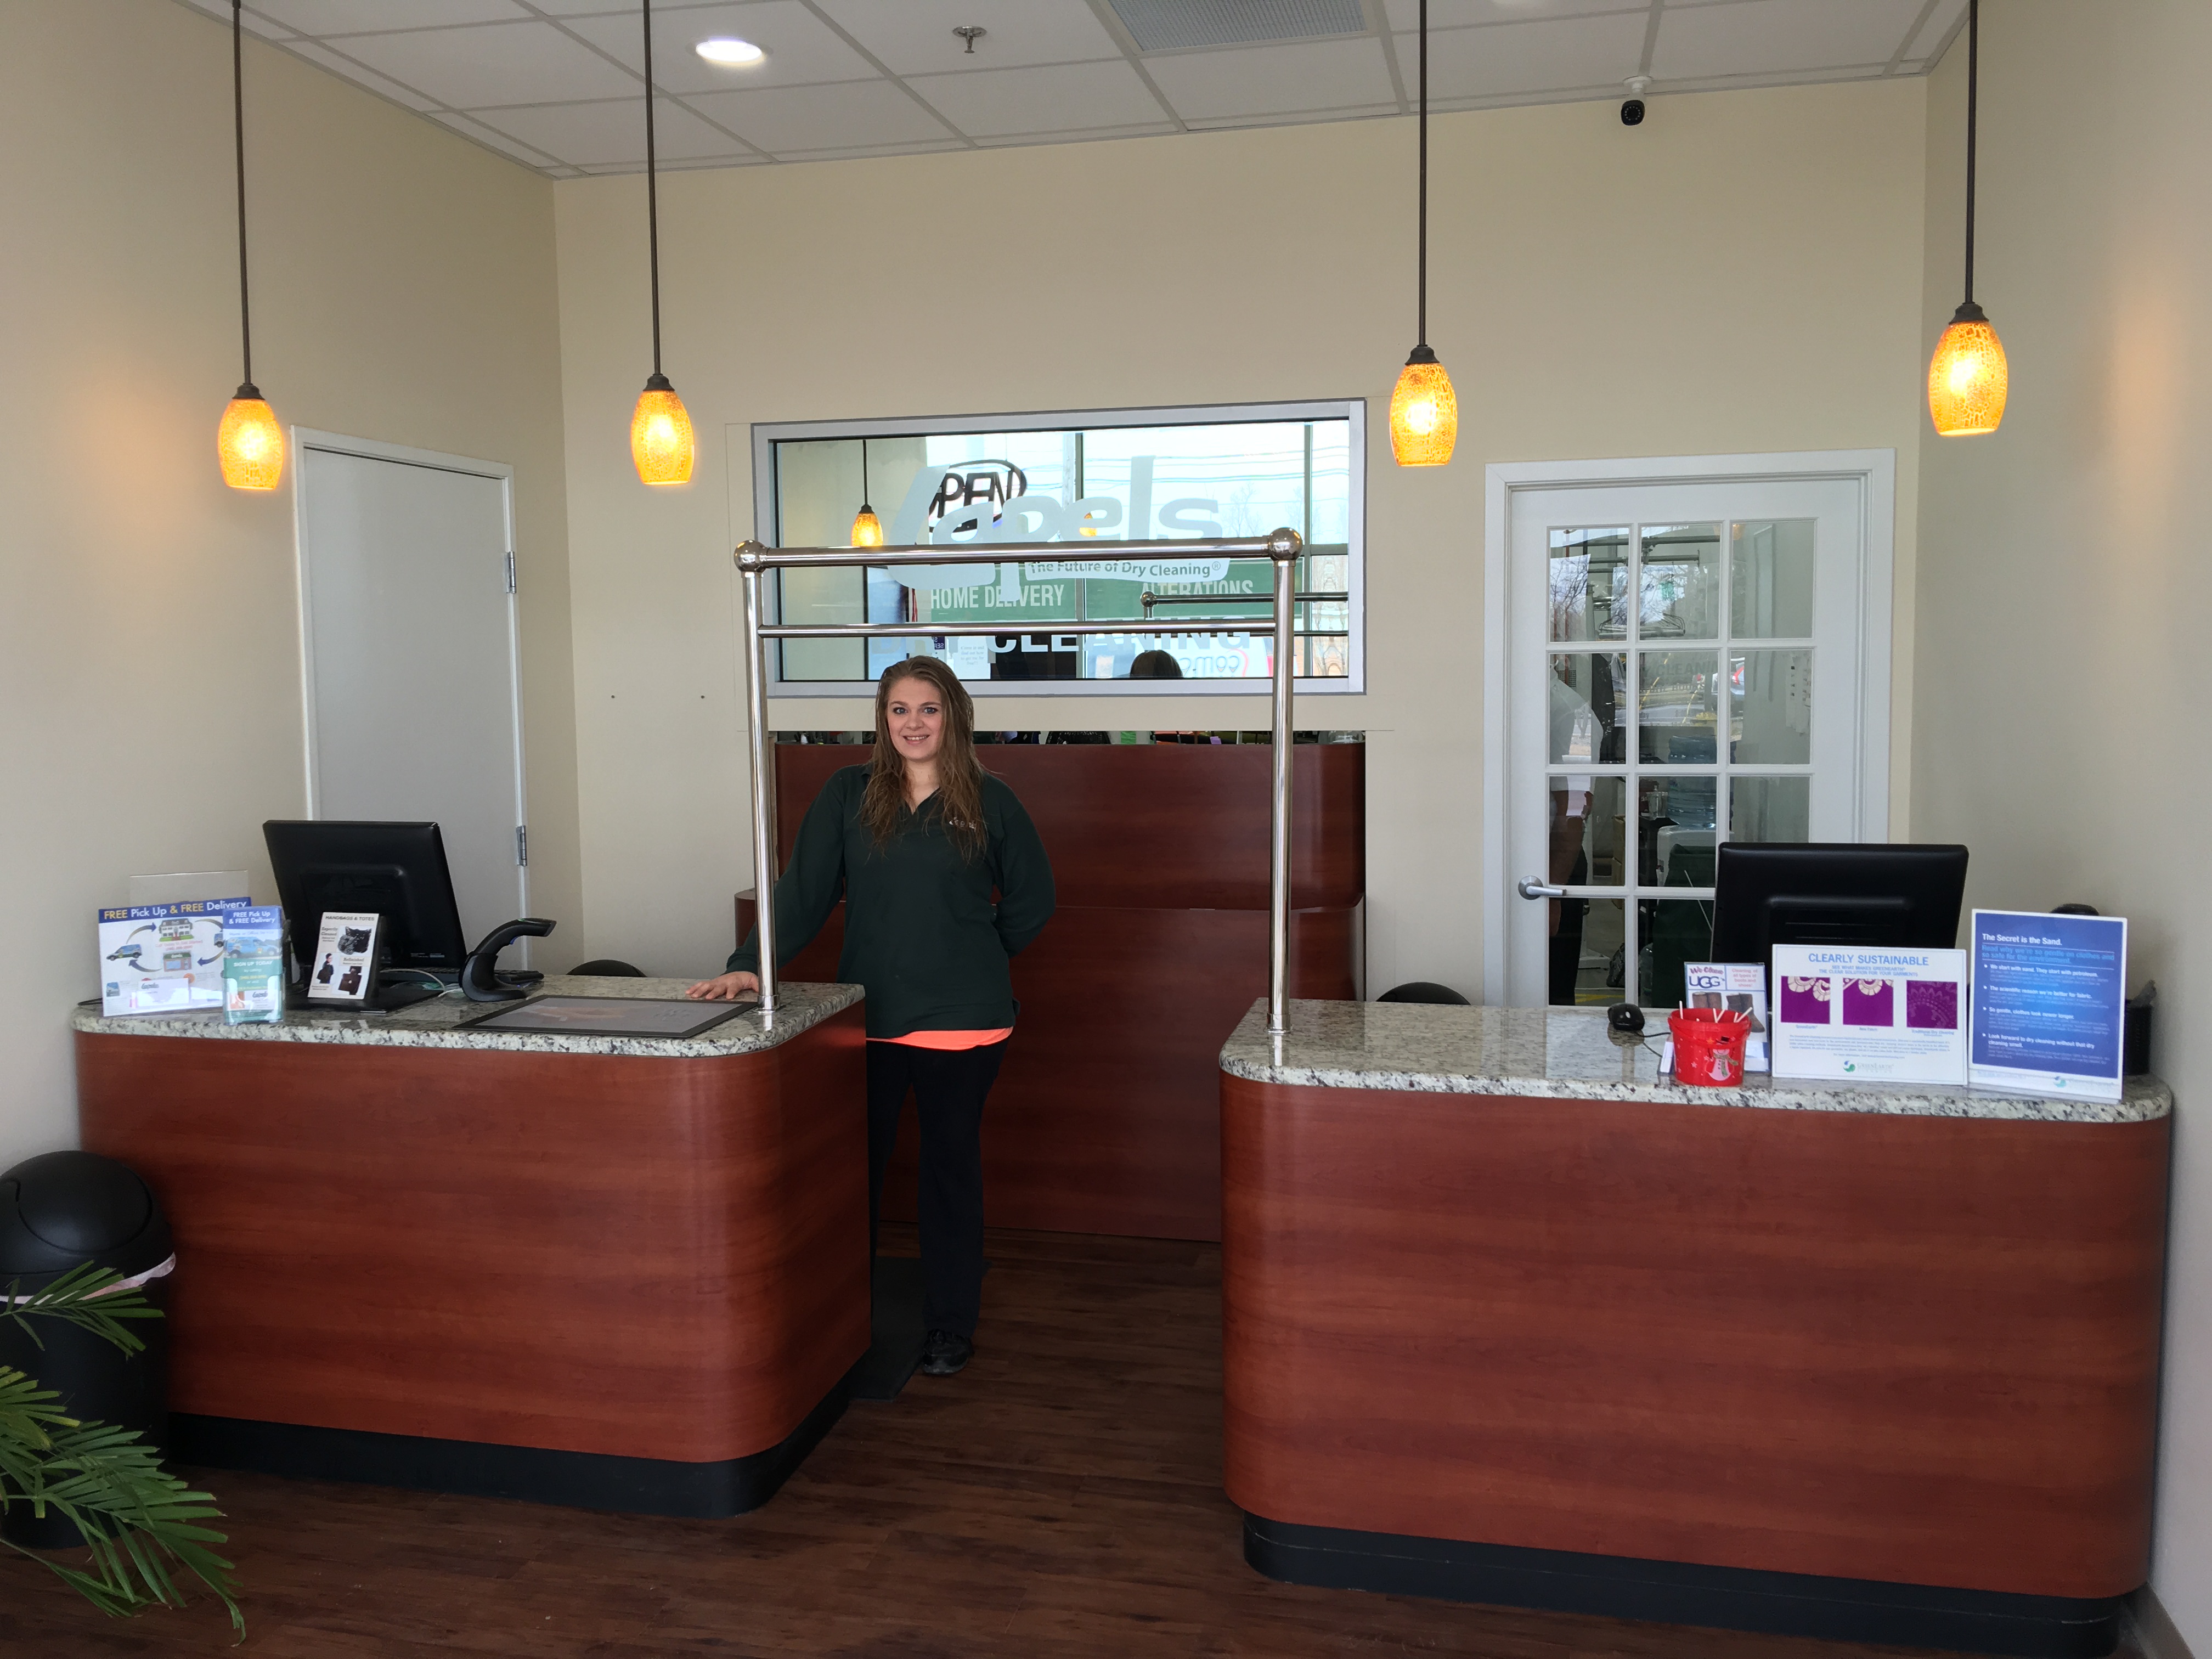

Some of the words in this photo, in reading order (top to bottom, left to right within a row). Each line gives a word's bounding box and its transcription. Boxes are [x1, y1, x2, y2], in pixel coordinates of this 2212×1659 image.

[929, 470, 1014, 518] PEN
[1104, 561, 1118, 572] of
[1122, 562, 1146, 577] Dry
[931, 586, 979, 608] HOME
[985, 584, 1064, 607] DEVERY
[104, 910, 128, 919] FREE
[131, 907, 150, 917] Pick
[153, 907, 167, 917] Up
[170, 906, 178, 914] &
[180, 903, 204, 913] FREE
[207, 901, 247, 911] Delivery
[1982, 933, 1995, 941] The
[1996, 934, 2020, 943] Secret
[2029, 936, 2041, 944] the
[2042, 937, 2063, 945] Sand.
[1808, 953, 1854, 963] CLEARLY
[1858, 955, 1929, 966] SUSTAINABLE
[1689, 976, 1720, 989] UGG
